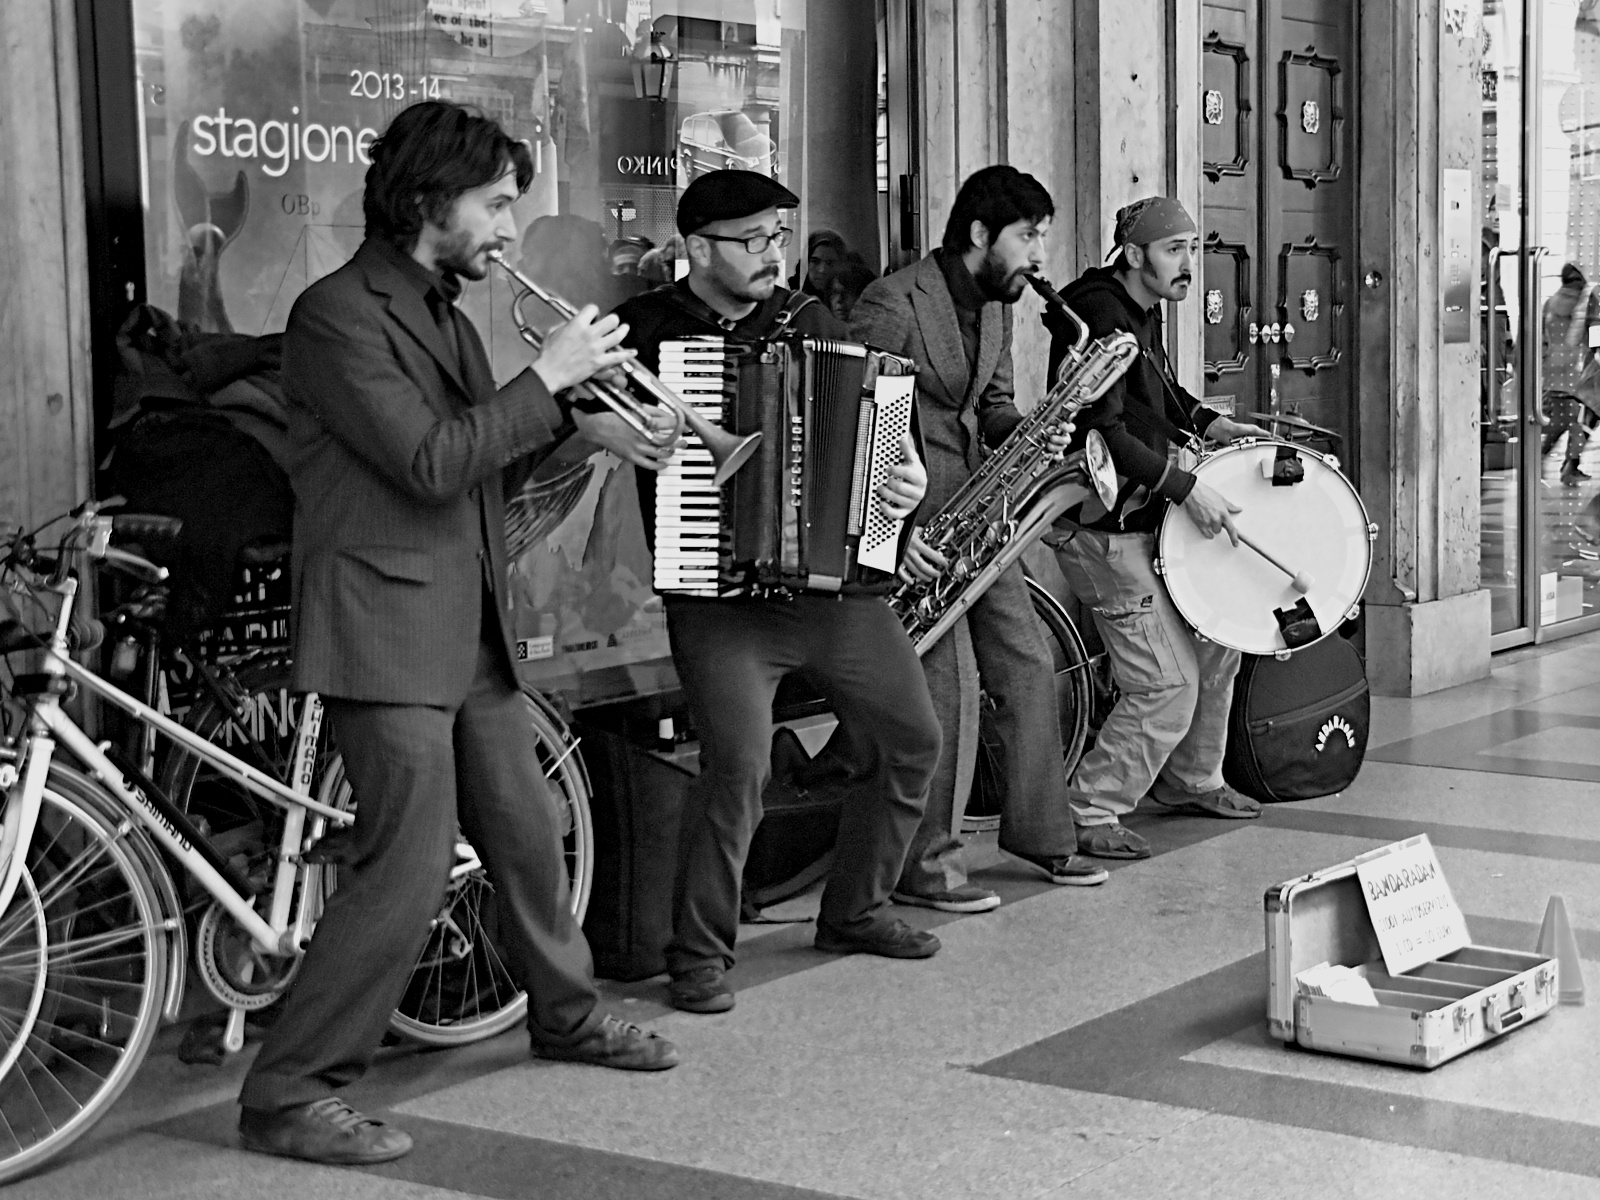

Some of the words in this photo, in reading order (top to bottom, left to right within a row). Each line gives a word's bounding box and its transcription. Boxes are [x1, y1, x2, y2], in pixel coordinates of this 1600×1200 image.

[461, 31, 474, 47] he
[478, 33, 488, 48] is
[469, 14, 487, 28] the
[193, 107, 378, 177] stagione
[790, 416, 803, 507] EXCELSIOR
